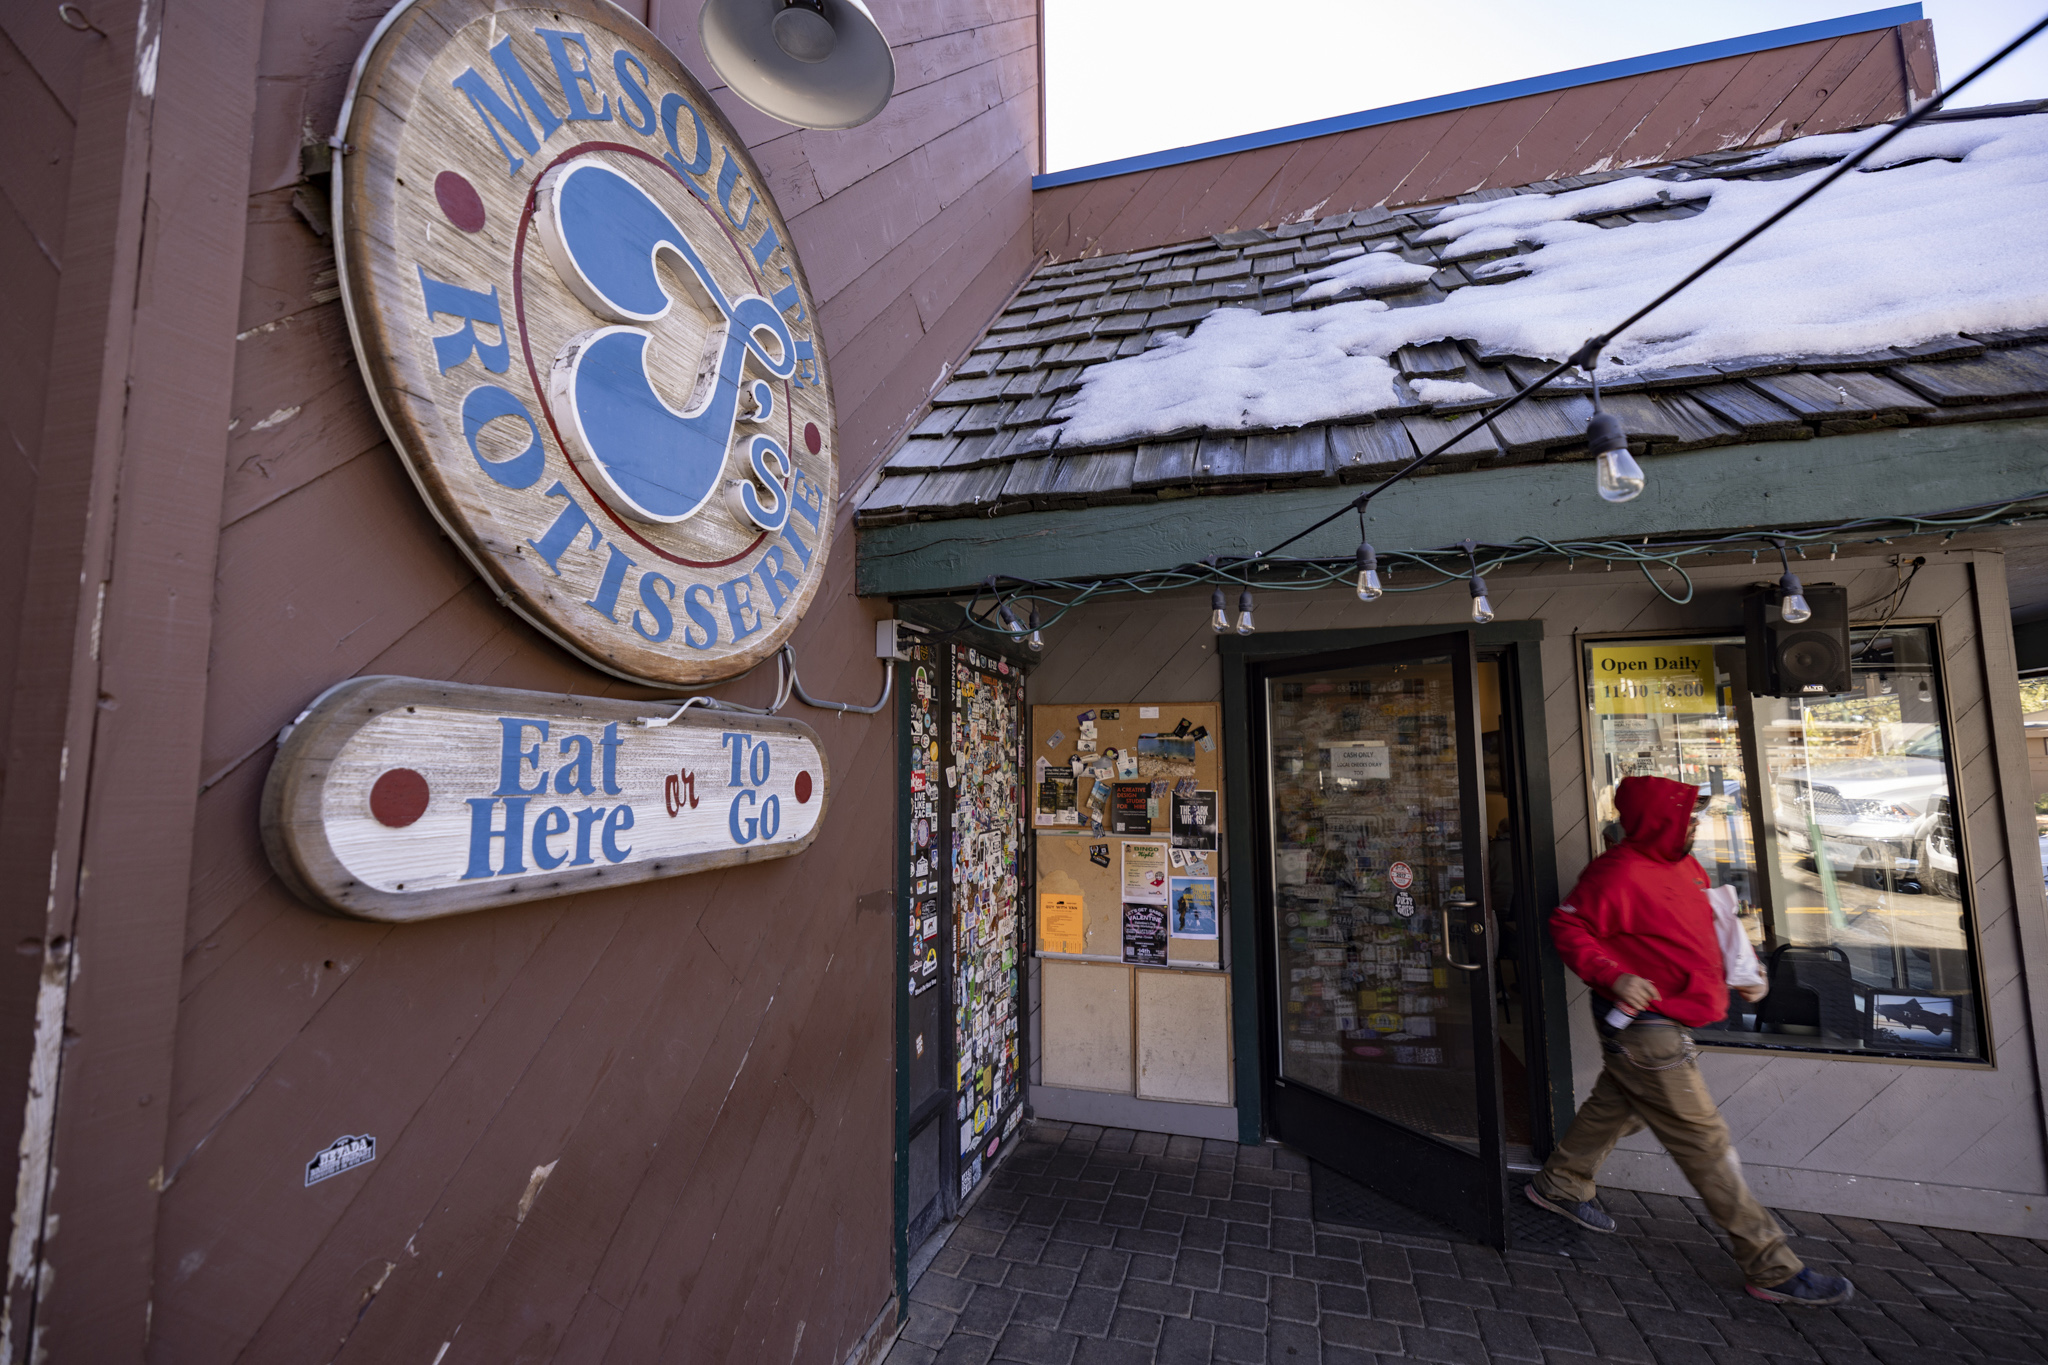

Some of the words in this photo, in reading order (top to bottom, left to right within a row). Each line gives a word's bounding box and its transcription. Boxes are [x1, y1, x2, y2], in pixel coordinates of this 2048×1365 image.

[452, 27, 818, 389] MESQUITE
[416, 264, 824, 650] ROTISSERIE
[1601, 657, 1648, 675] Open
[1653, 656, 1701, 673] Daily
[1666, 683, 1705, 698] 8:00
[492, 716, 625, 797] Eat
[665, 768, 700, 819] or
[914, 792, 925, 801] LIVE
[914, 801, 925, 810] LIKE
[1180, 805, 1191, 815] THE
[1191, 805, 1208, 816] ARK
[914, 809, 925, 819] ZAC
[460, 795, 635, 881] Here
[1137, 851, 1154, 859] Night
[1128, 915, 1162, 923] VALENTINE
